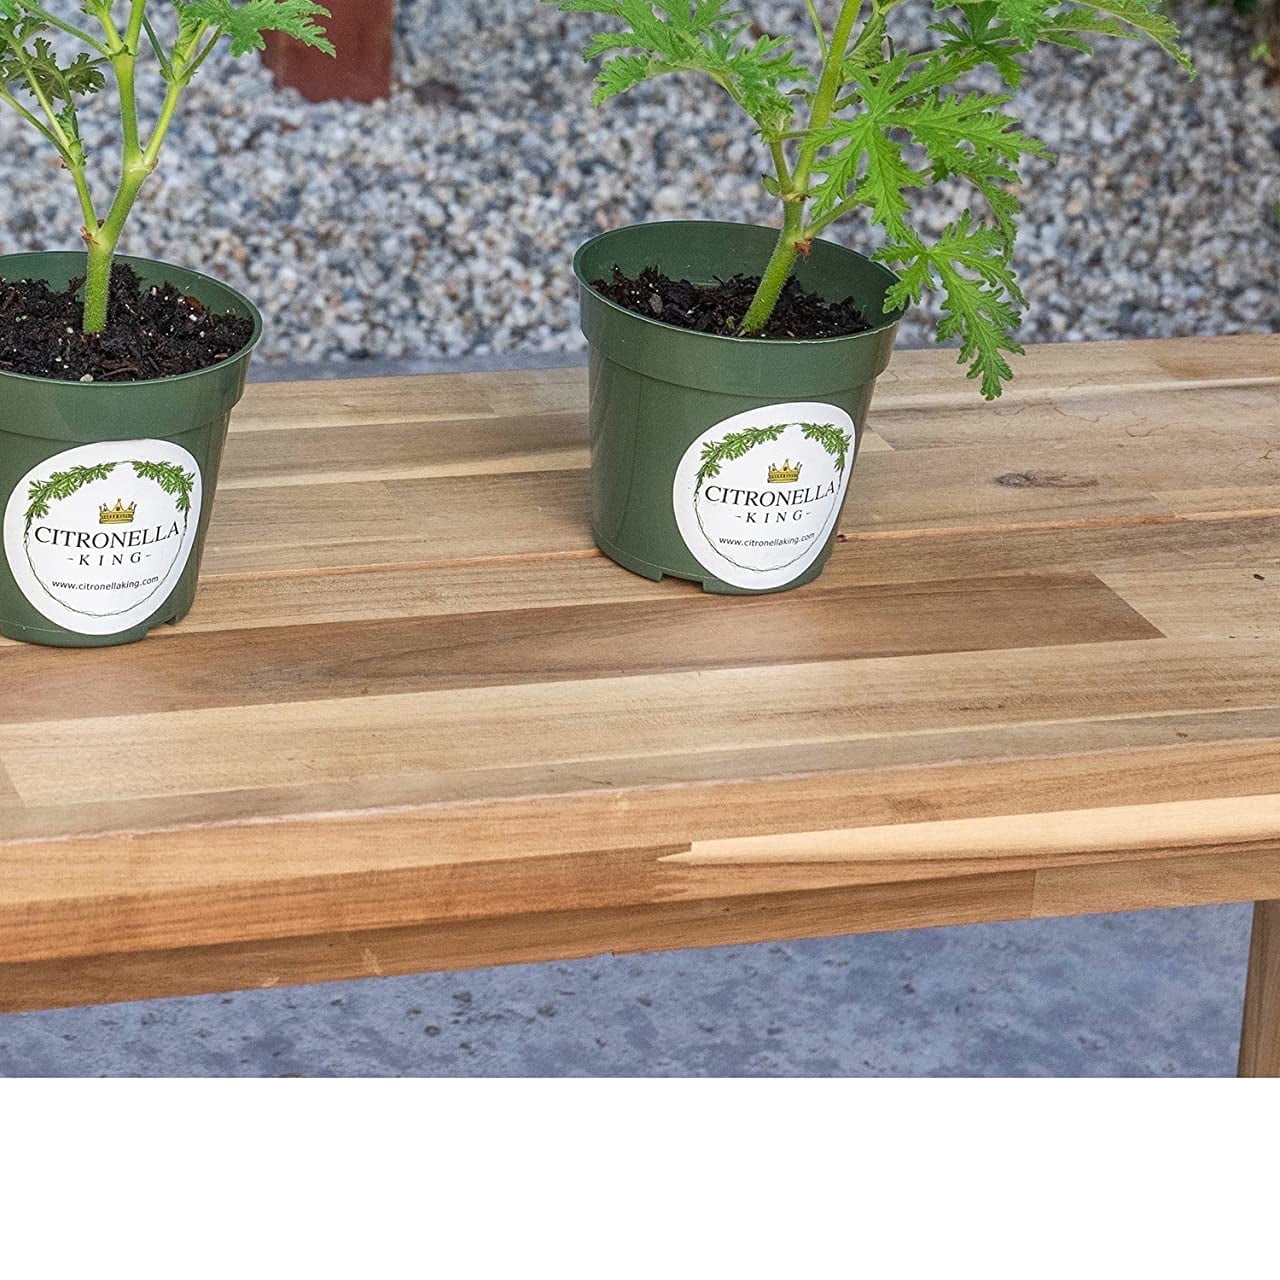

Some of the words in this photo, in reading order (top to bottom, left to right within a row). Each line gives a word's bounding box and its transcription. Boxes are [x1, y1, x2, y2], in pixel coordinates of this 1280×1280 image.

[705, 480, 835, 508] CITRONELLA
[34, 521, 180, 549] CITRONELLA
[719, 532, 815, 547] www.citronellaking.com
[52, 575, 159, 591] www.citronellaking.com
